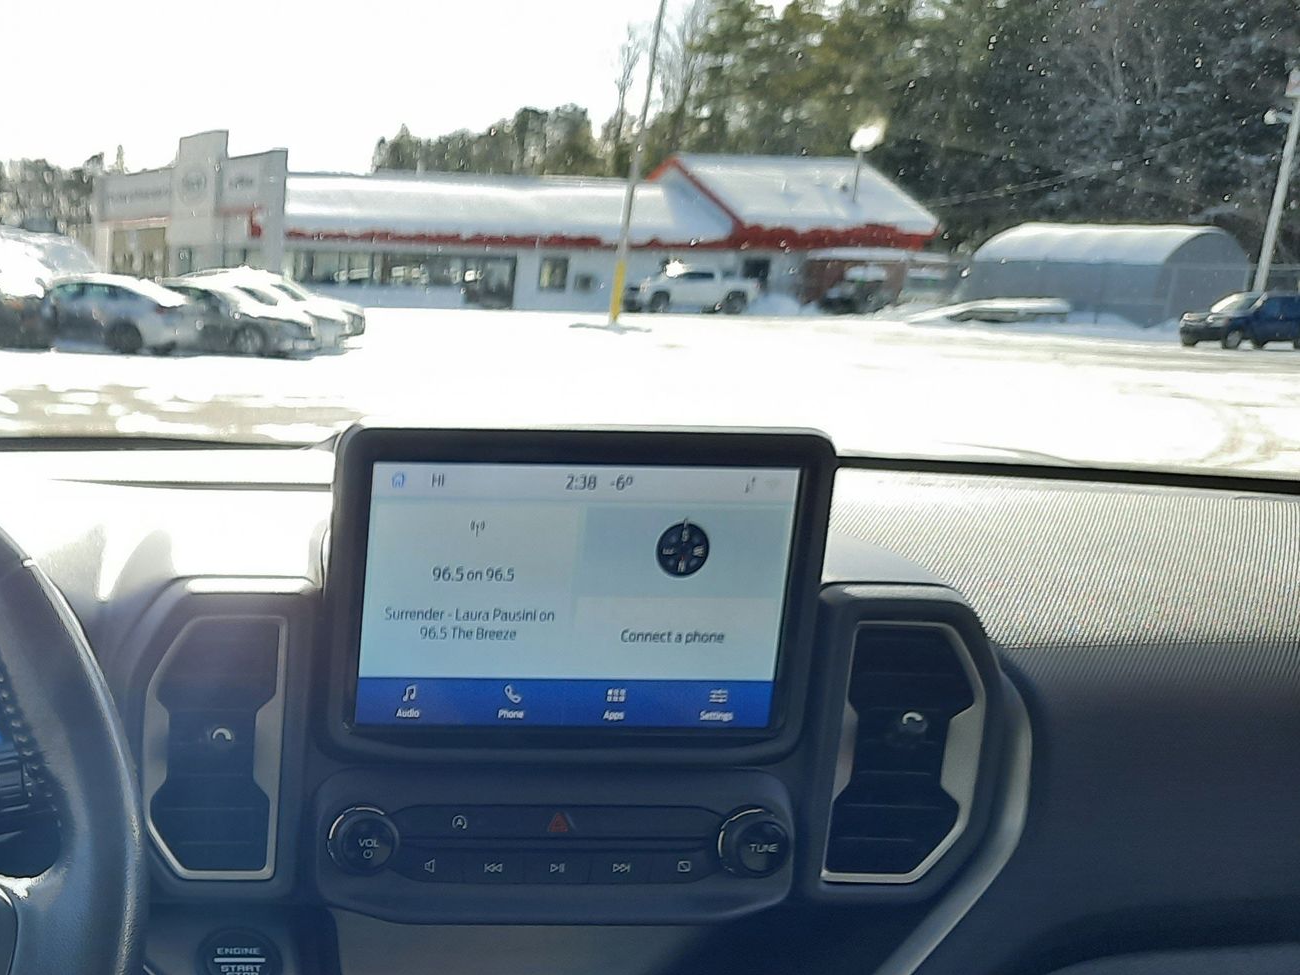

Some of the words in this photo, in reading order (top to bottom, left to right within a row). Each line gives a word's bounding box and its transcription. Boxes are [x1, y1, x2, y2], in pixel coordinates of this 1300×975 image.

[565, 474, 598, 491] 2:38
[432, 567, 465, 583] 96.5
[466, 572, 483, 582] on
[485, 567, 515, 583] 96.5
[384, 607, 445, 622] Surrender
[455, 607, 490, 622] Laura
[492, 608, 538, 622] Pausini
[539, 611, 555, 622] on
[419, 628, 448, 641] 96.5
[451, 628, 473, 641] The
[476, 628, 517, 641] Breeze
[620, 628, 672, 643] Connect
[674, 633, 683, 643] a
[685, 630, 725, 645] phone
[396, 708, 420, 719] Audio
[498, 709, 525, 720] Phone
[602, 710, 626, 722] Apps
[699, 711, 734, 723] Settings
[358, 838, 379, 848] VOL
[749, 843, 778, 853] TUNE
[216, 947, 261, 955] ENGINE
[220, 964, 262, 973] START
